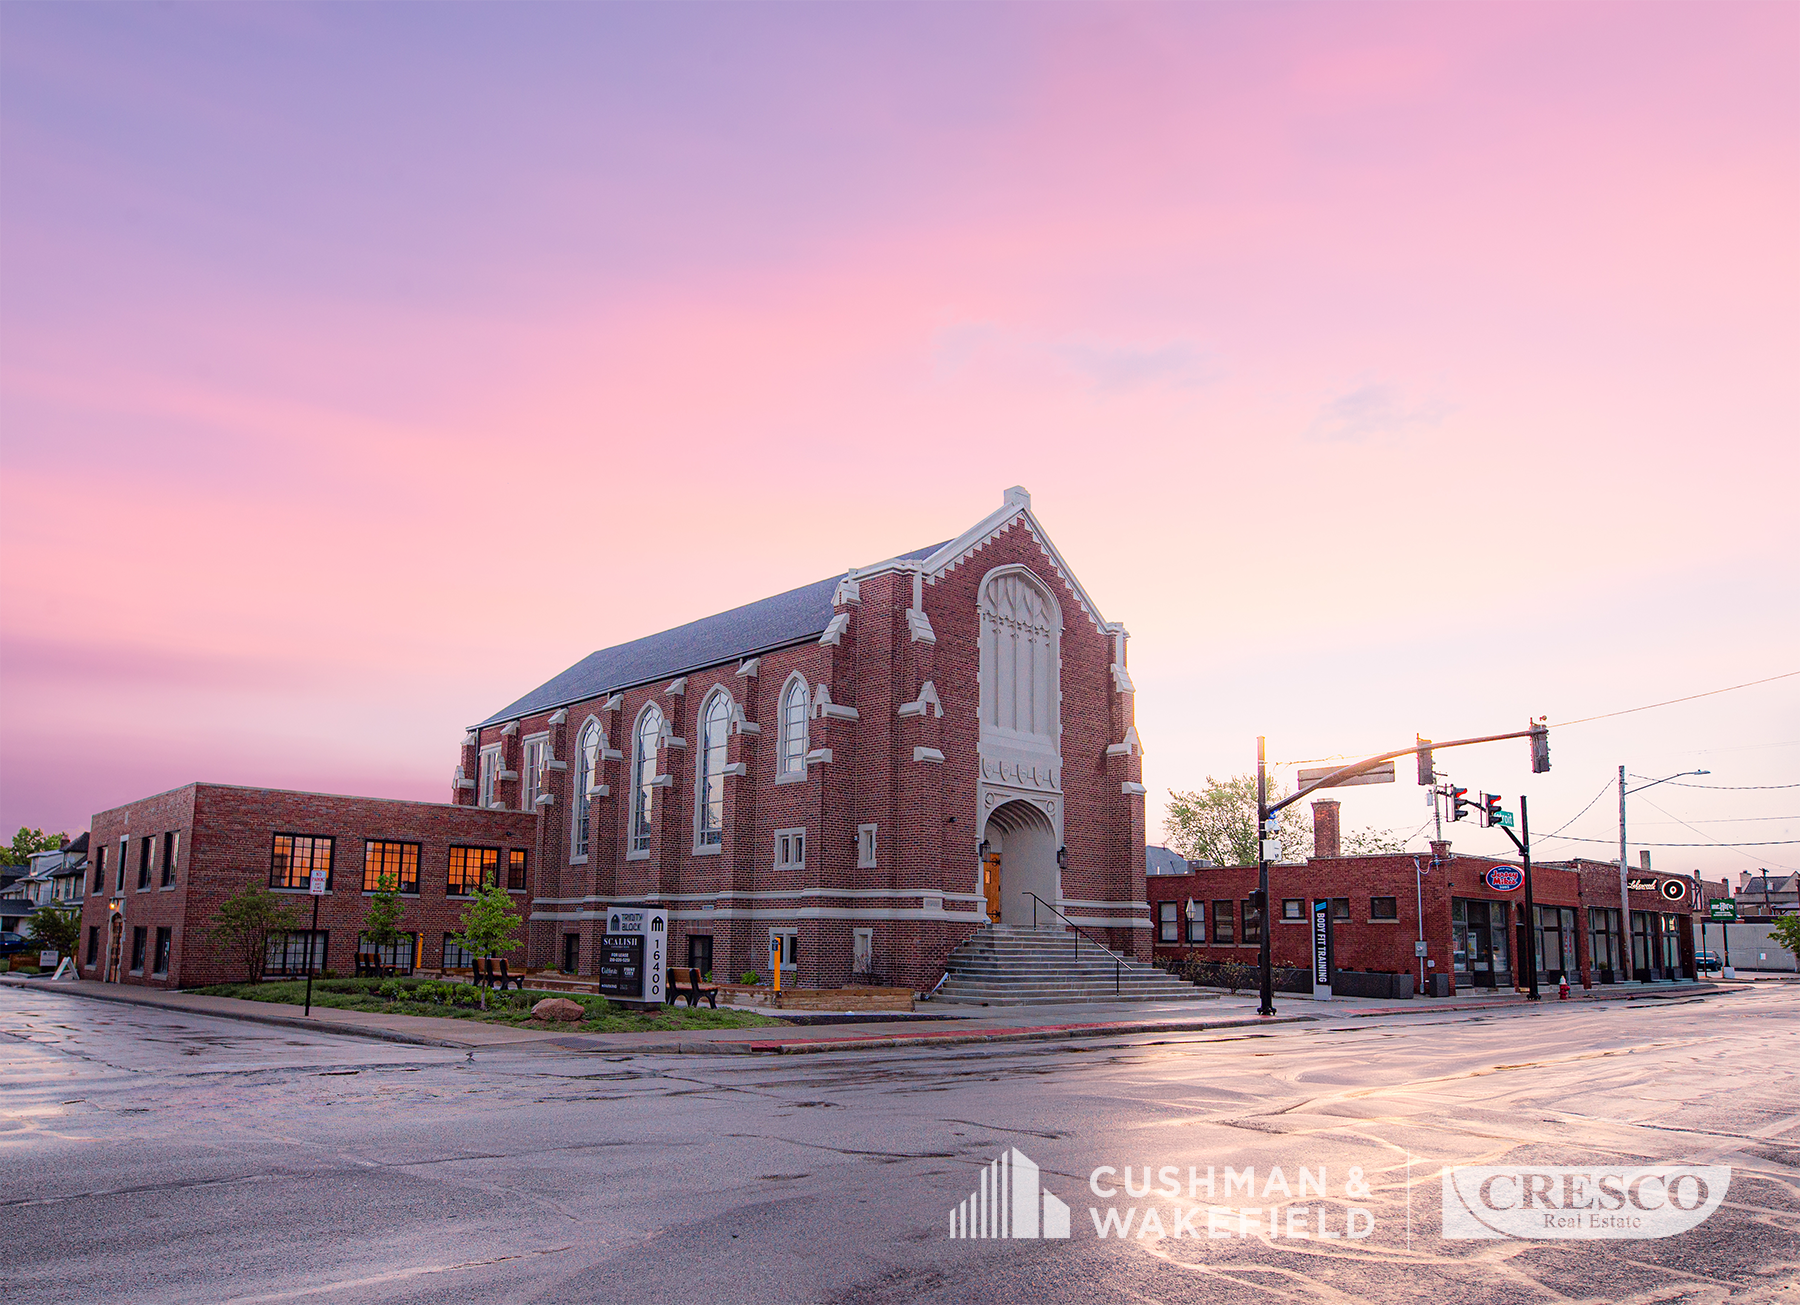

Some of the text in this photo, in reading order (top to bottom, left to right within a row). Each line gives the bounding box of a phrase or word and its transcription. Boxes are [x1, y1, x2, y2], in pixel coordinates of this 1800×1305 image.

[1491, 870, 1518, 880] Jersey
[621, 913, 643, 922] TRINITY
[621, 923, 642, 931] BLOCK
[603, 937, 638, 946] SCALISH
[1316, 912, 1327, 983] BODY FIT TRAINING
[652, 939, 661, 995] 16400
